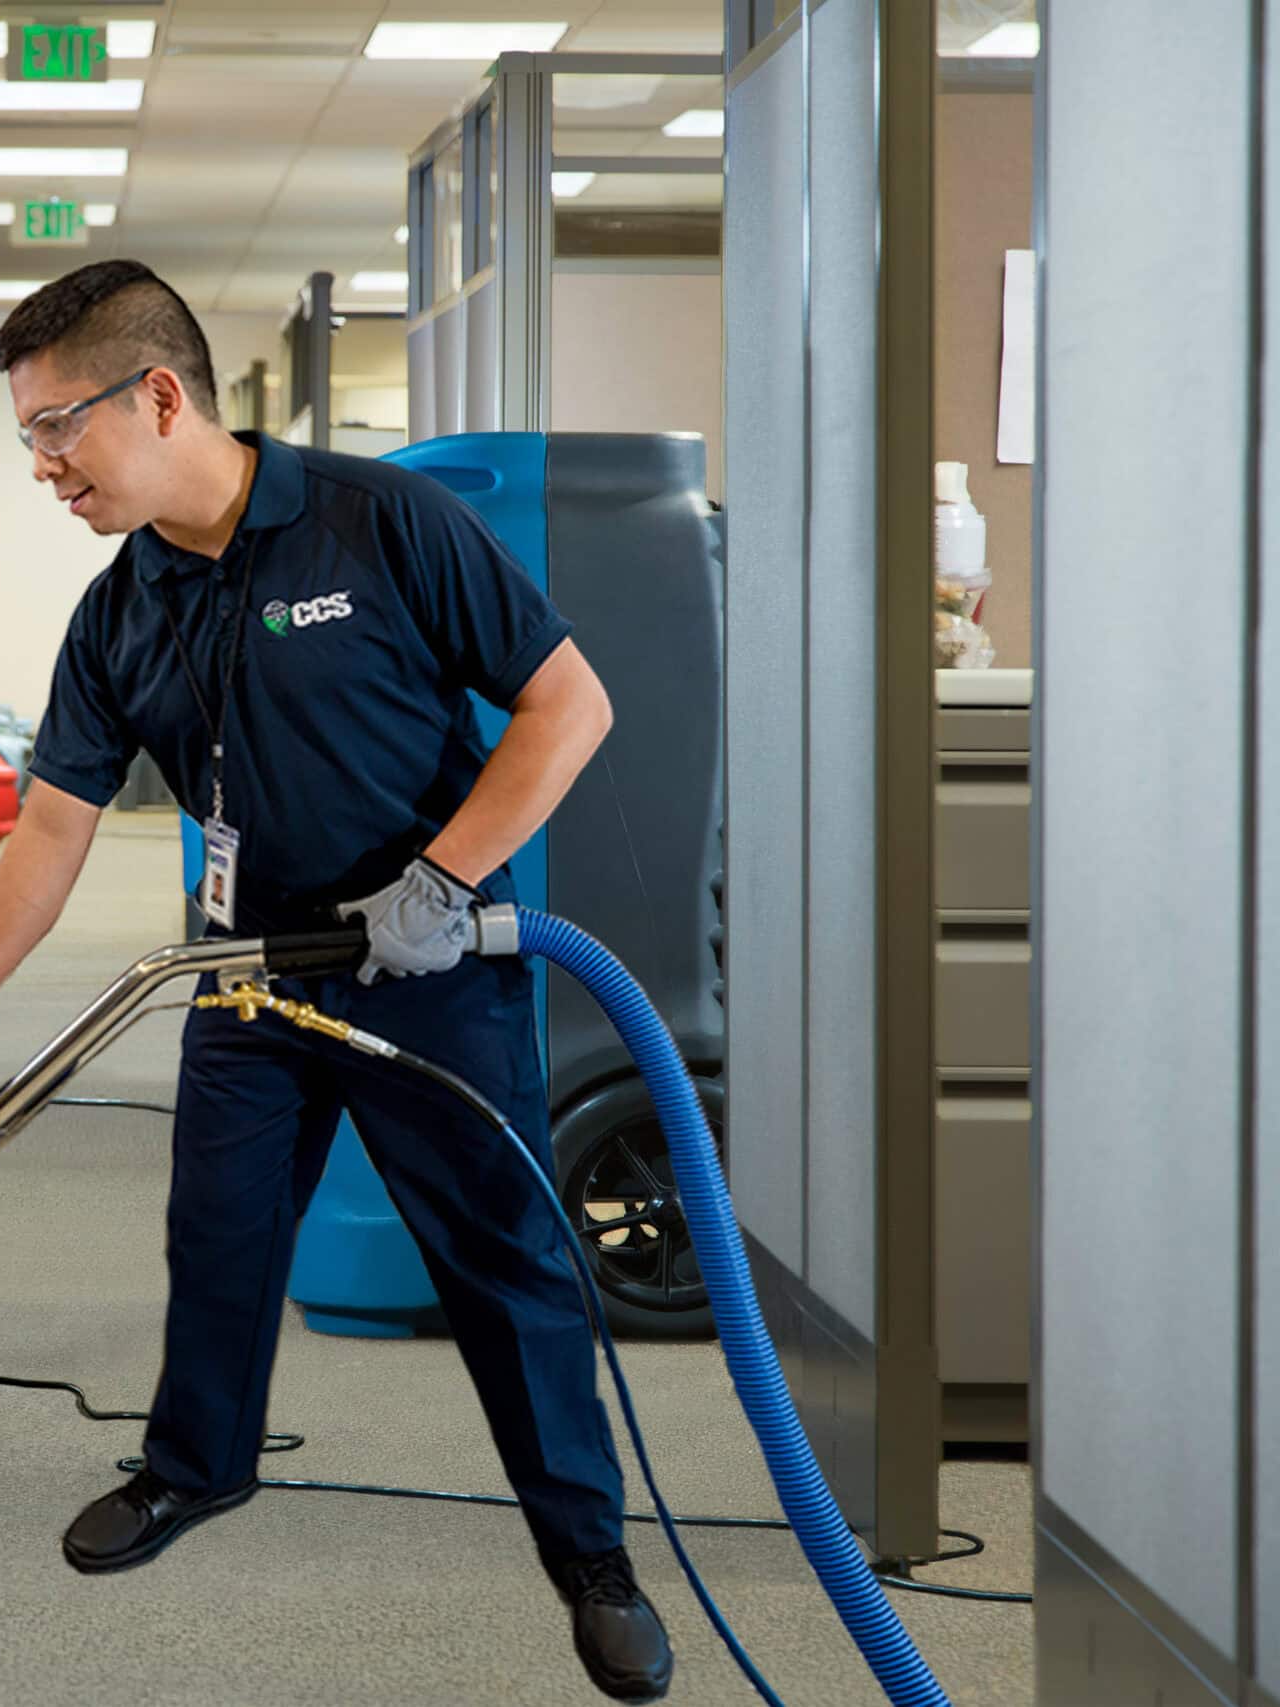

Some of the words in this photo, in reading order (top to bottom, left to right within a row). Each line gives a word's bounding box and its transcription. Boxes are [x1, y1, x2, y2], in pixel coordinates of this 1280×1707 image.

[22, 24, 96, 79] EXIT
[25, 202, 75, 239] EXIT
[291, 592, 353, 627] CCS
